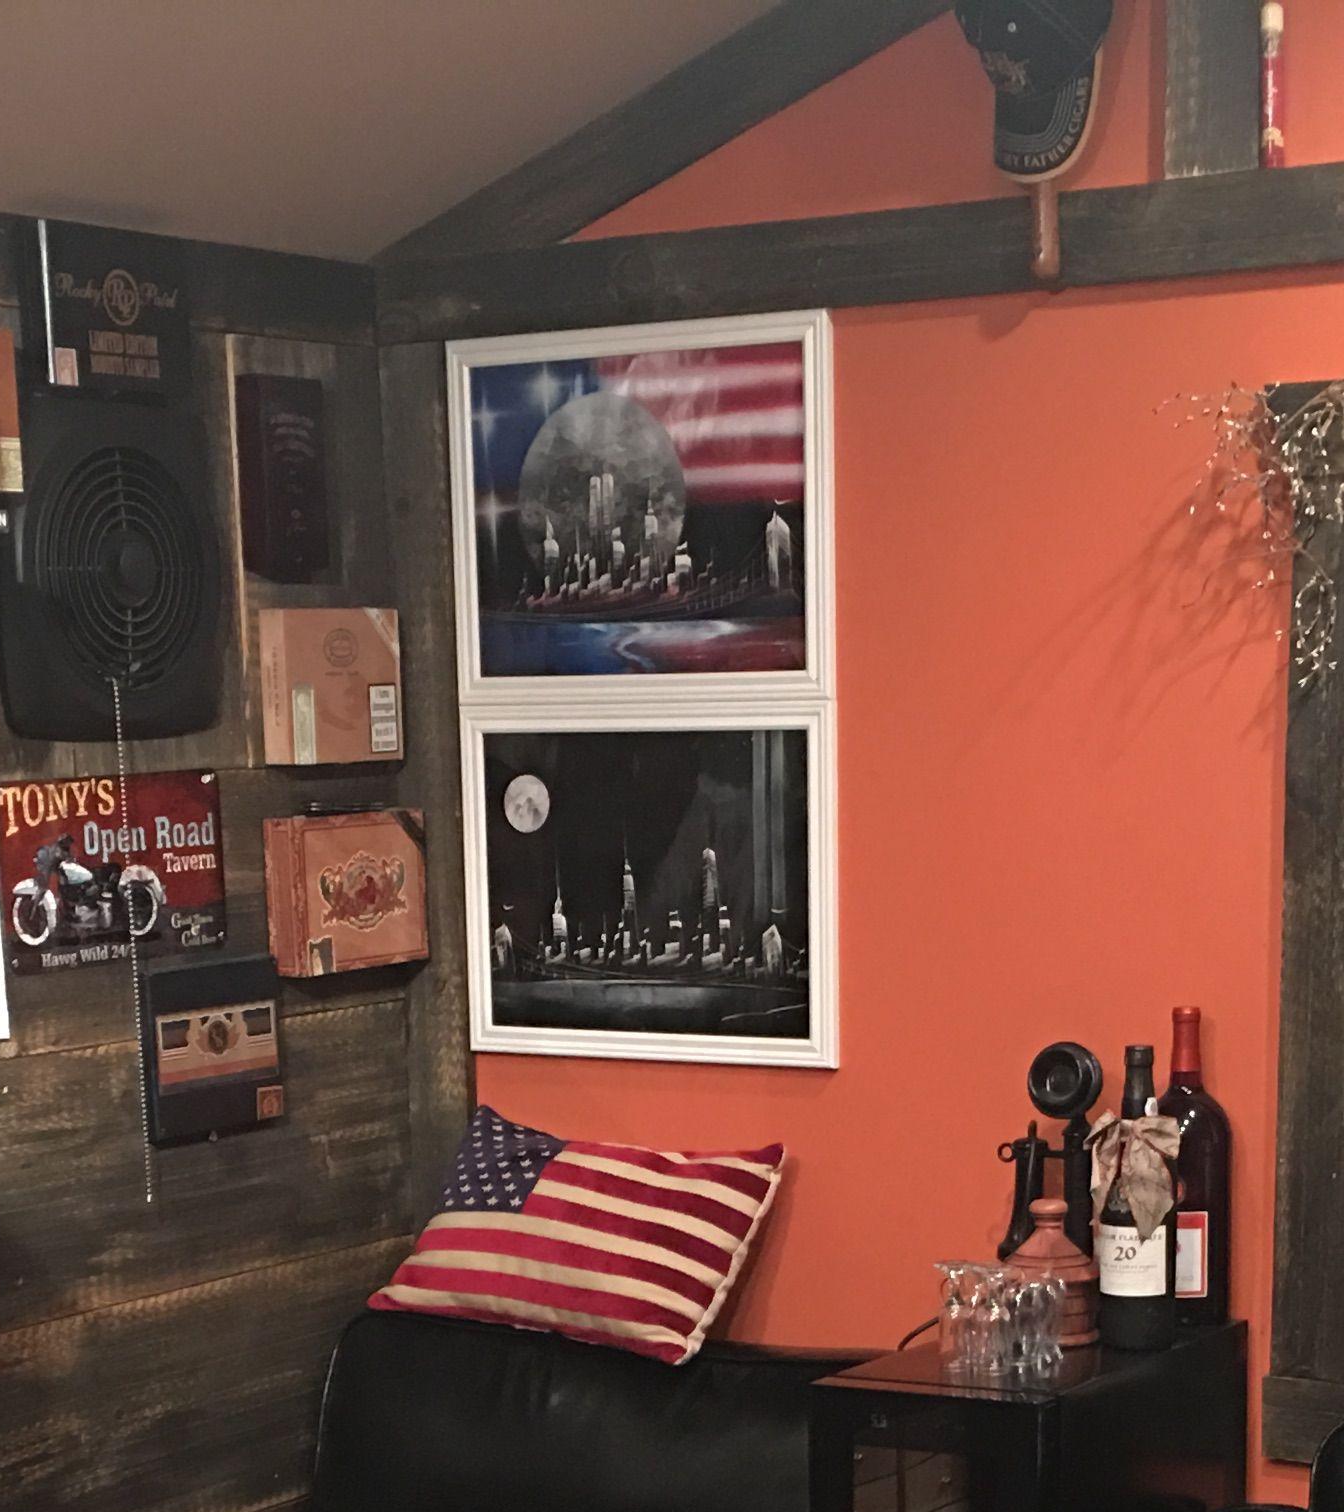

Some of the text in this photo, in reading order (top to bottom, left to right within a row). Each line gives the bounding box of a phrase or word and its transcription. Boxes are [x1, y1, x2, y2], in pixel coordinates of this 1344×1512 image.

[83, 812, 215, 863] Open Road
[162, 852, 217, 873] Tavern
[41, 950, 78, 968] Hawg
[80, 945, 109, 963] Wild
[1114, 1245, 1138, 1262] 20
